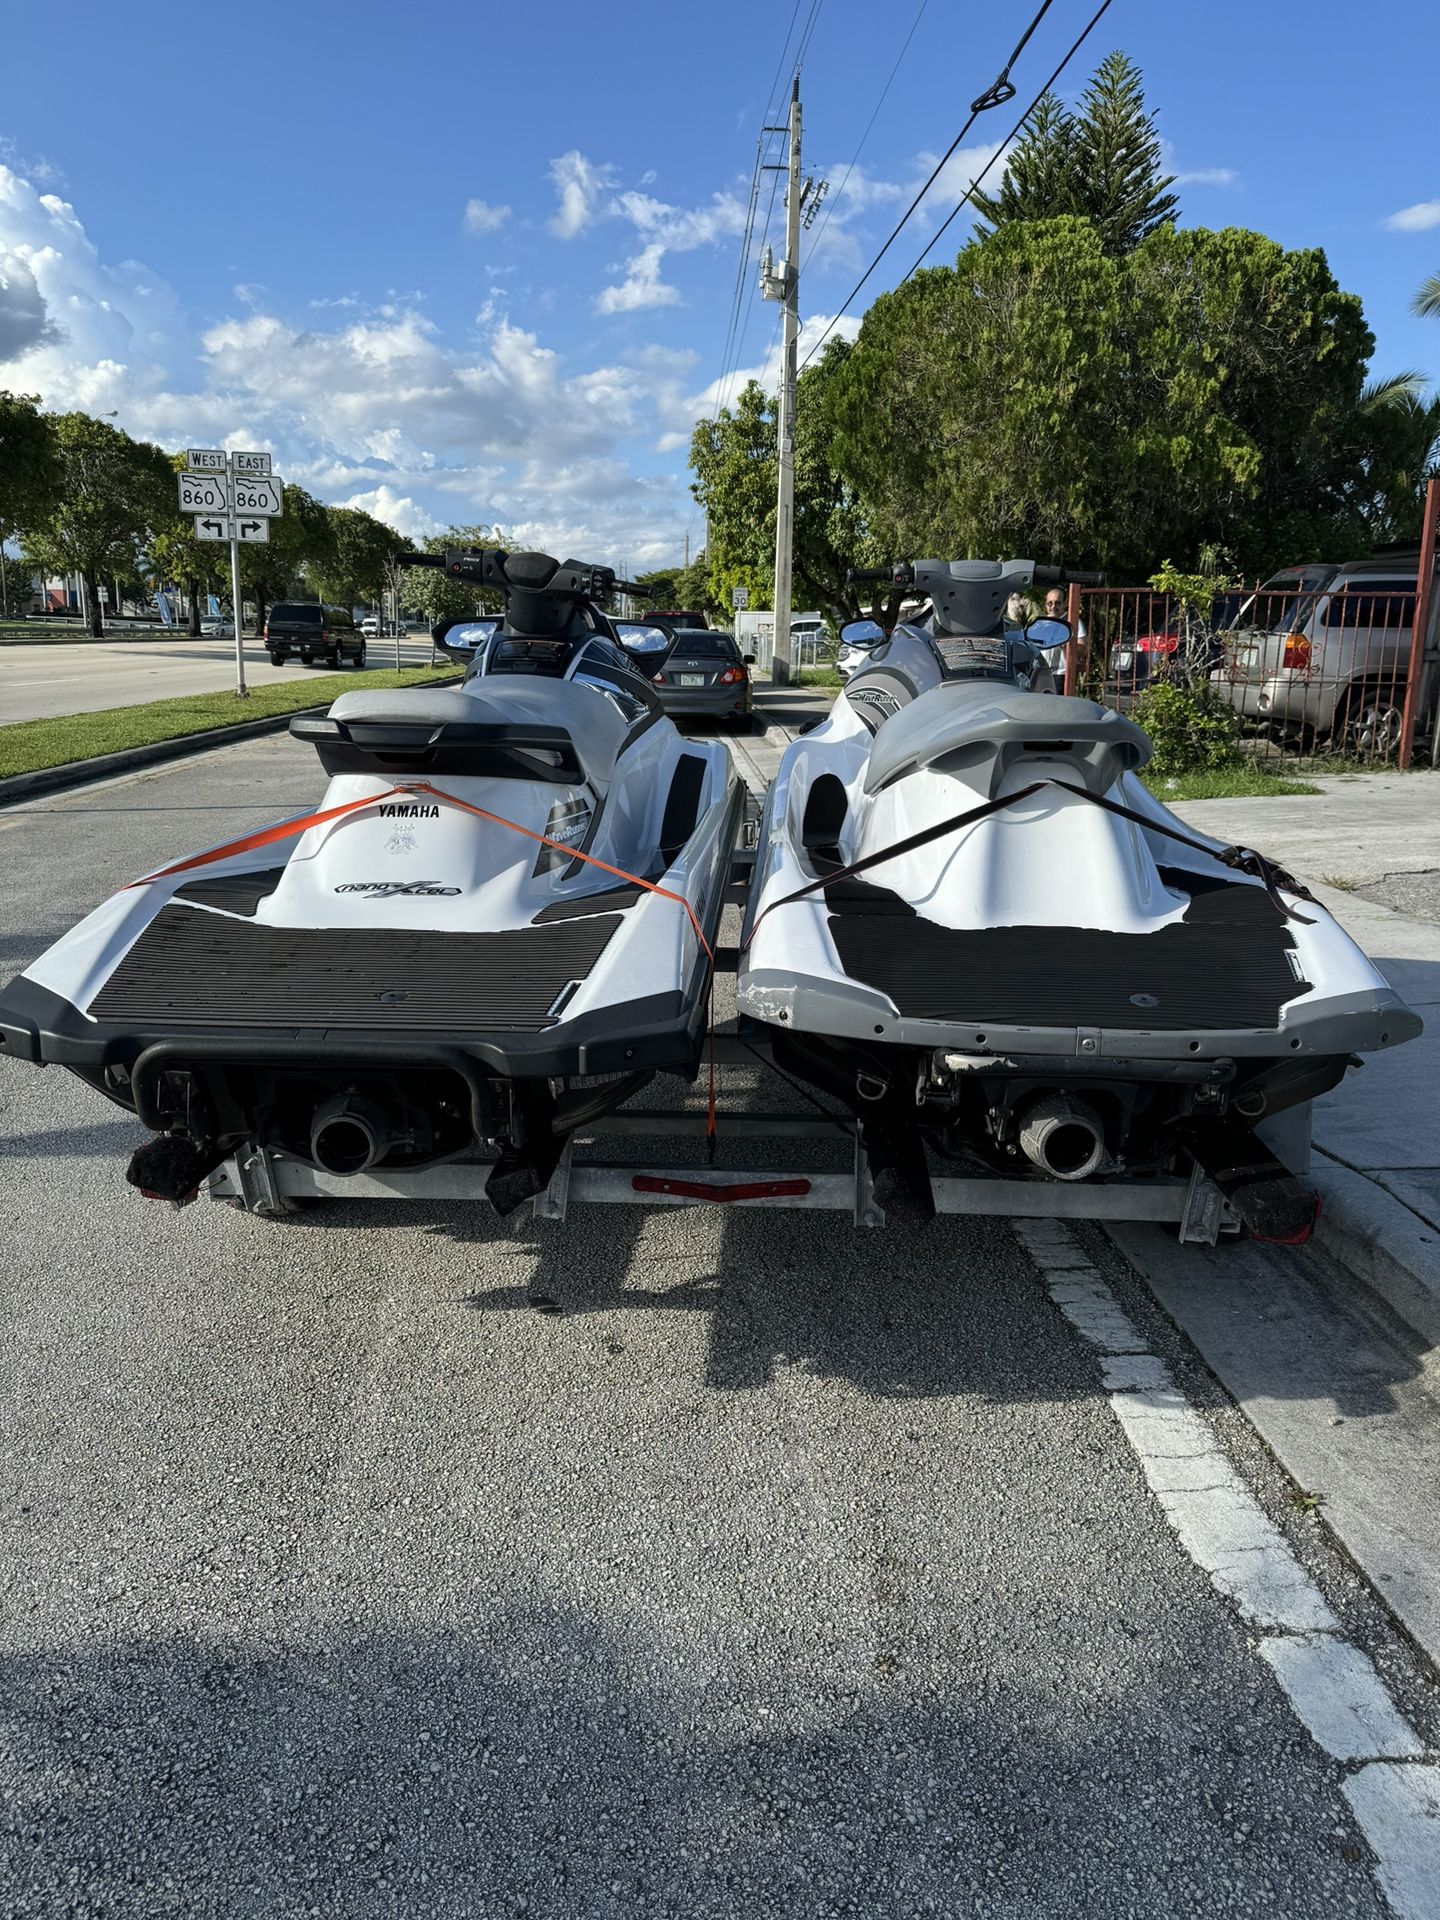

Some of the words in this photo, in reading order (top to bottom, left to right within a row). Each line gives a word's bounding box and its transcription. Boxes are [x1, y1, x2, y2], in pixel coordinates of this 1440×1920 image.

[192, 452, 222, 467] WEST
[238, 455, 264, 469] EAST
[182, 489, 214, 505] 860
[236, 492, 268, 508] 860
[734, 597, 746, 605] 30
[379, 804, 439, 818] YAMAHA
